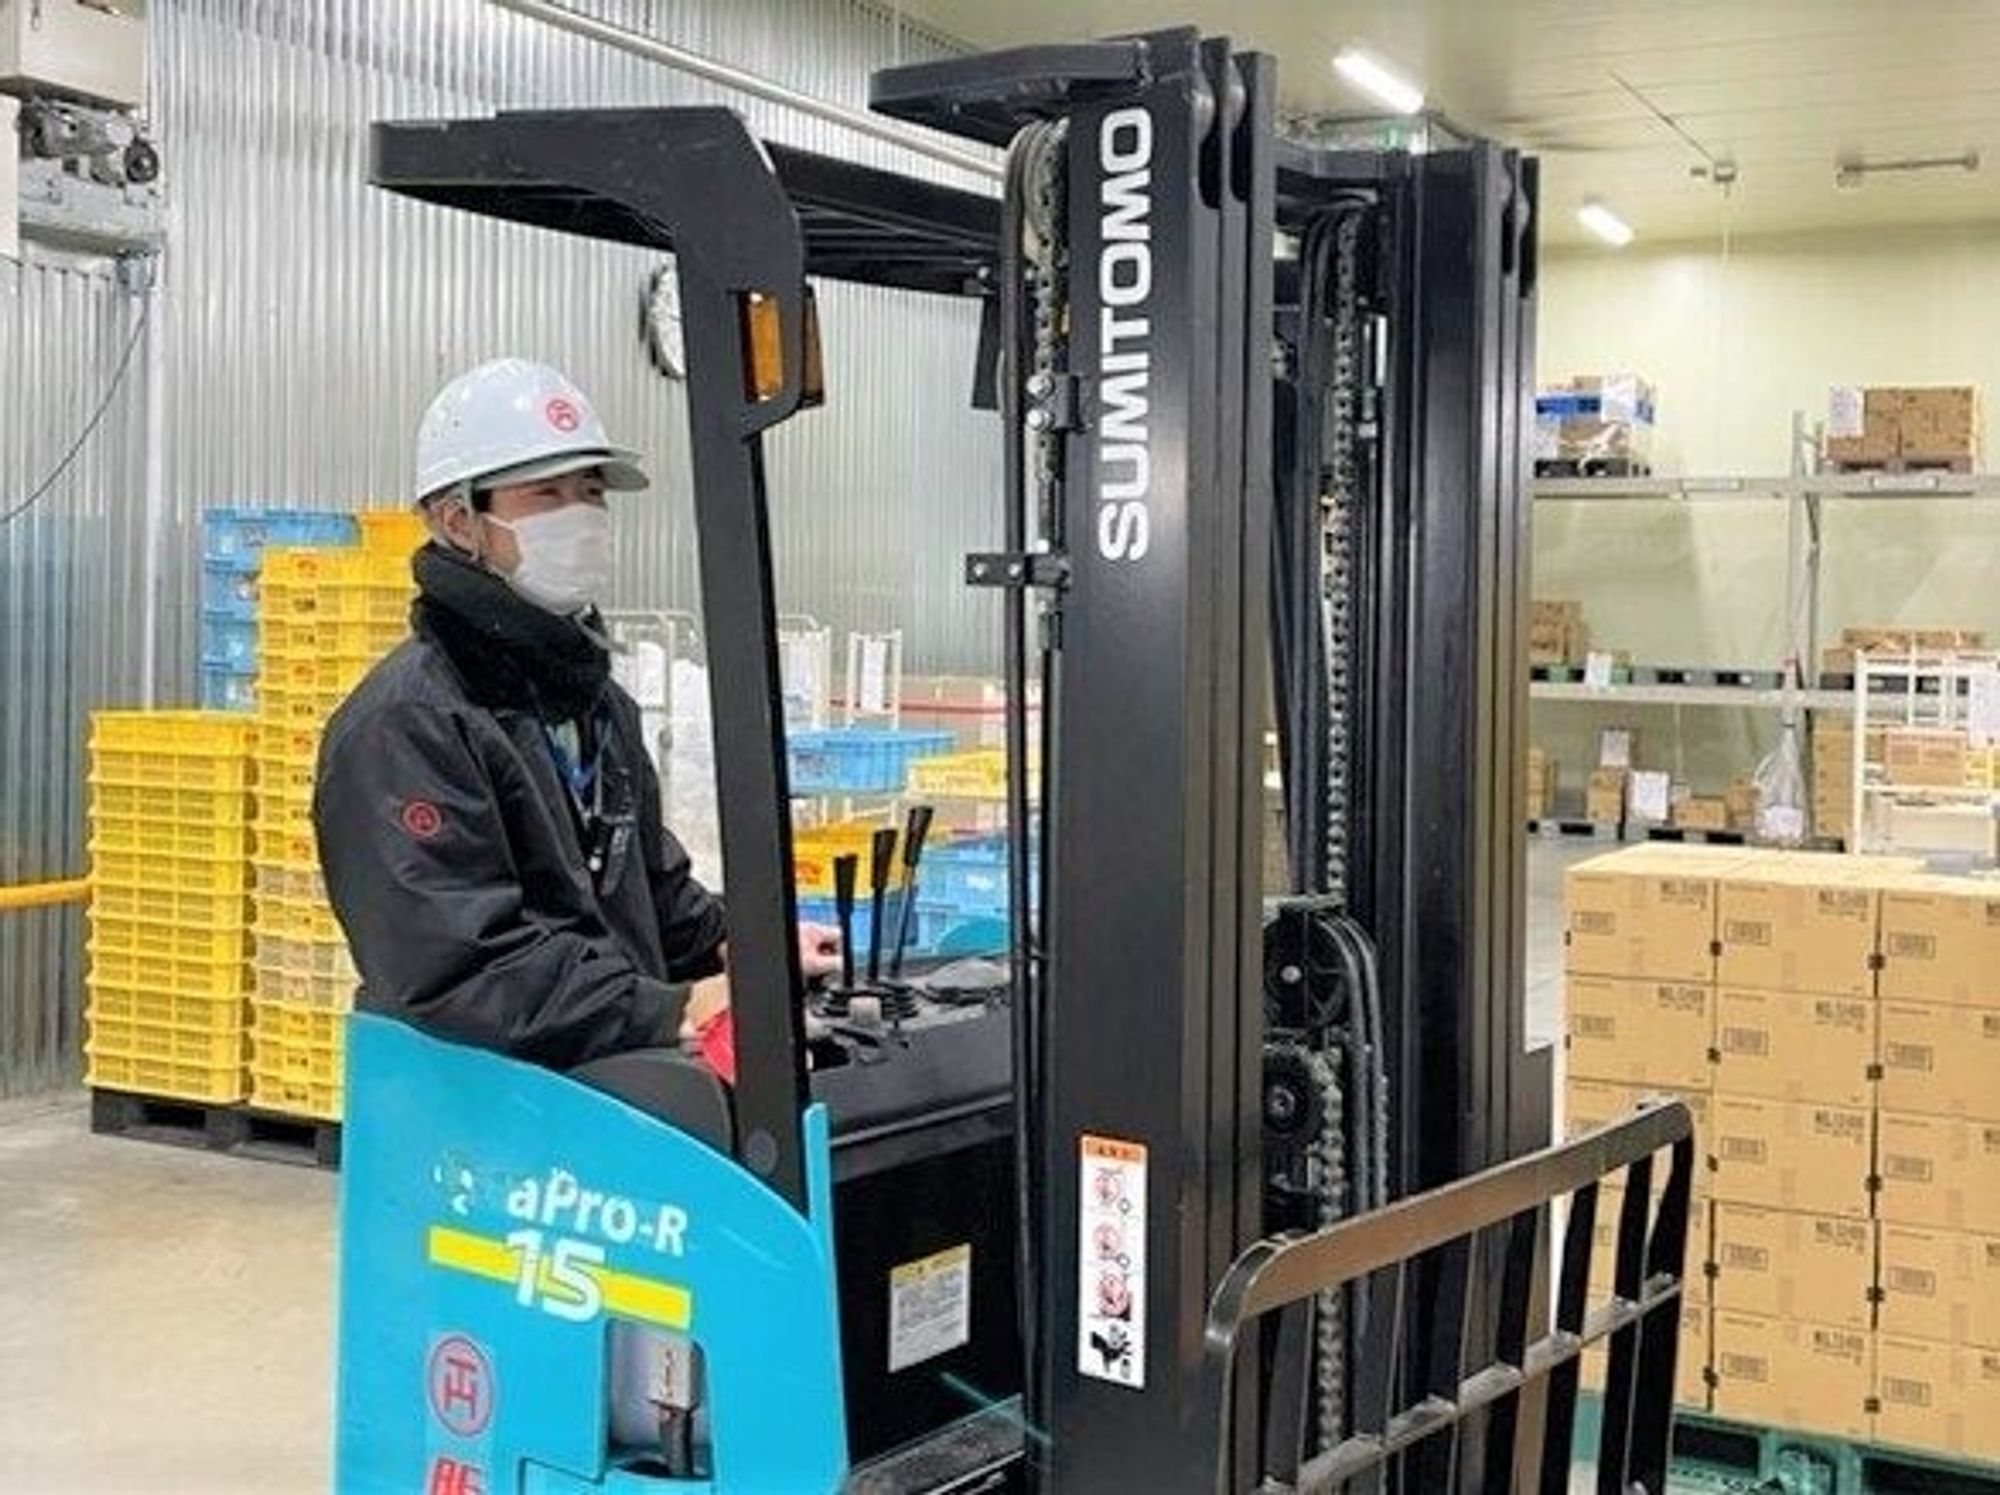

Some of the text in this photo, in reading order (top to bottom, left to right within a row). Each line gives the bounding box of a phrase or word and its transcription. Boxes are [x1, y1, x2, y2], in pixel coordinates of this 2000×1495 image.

[1100, 108, 1152, 561] SUMITOMO
[433, 1163, 688, 1257] aPro-R
[506, 1229, 606, 1323] 15
